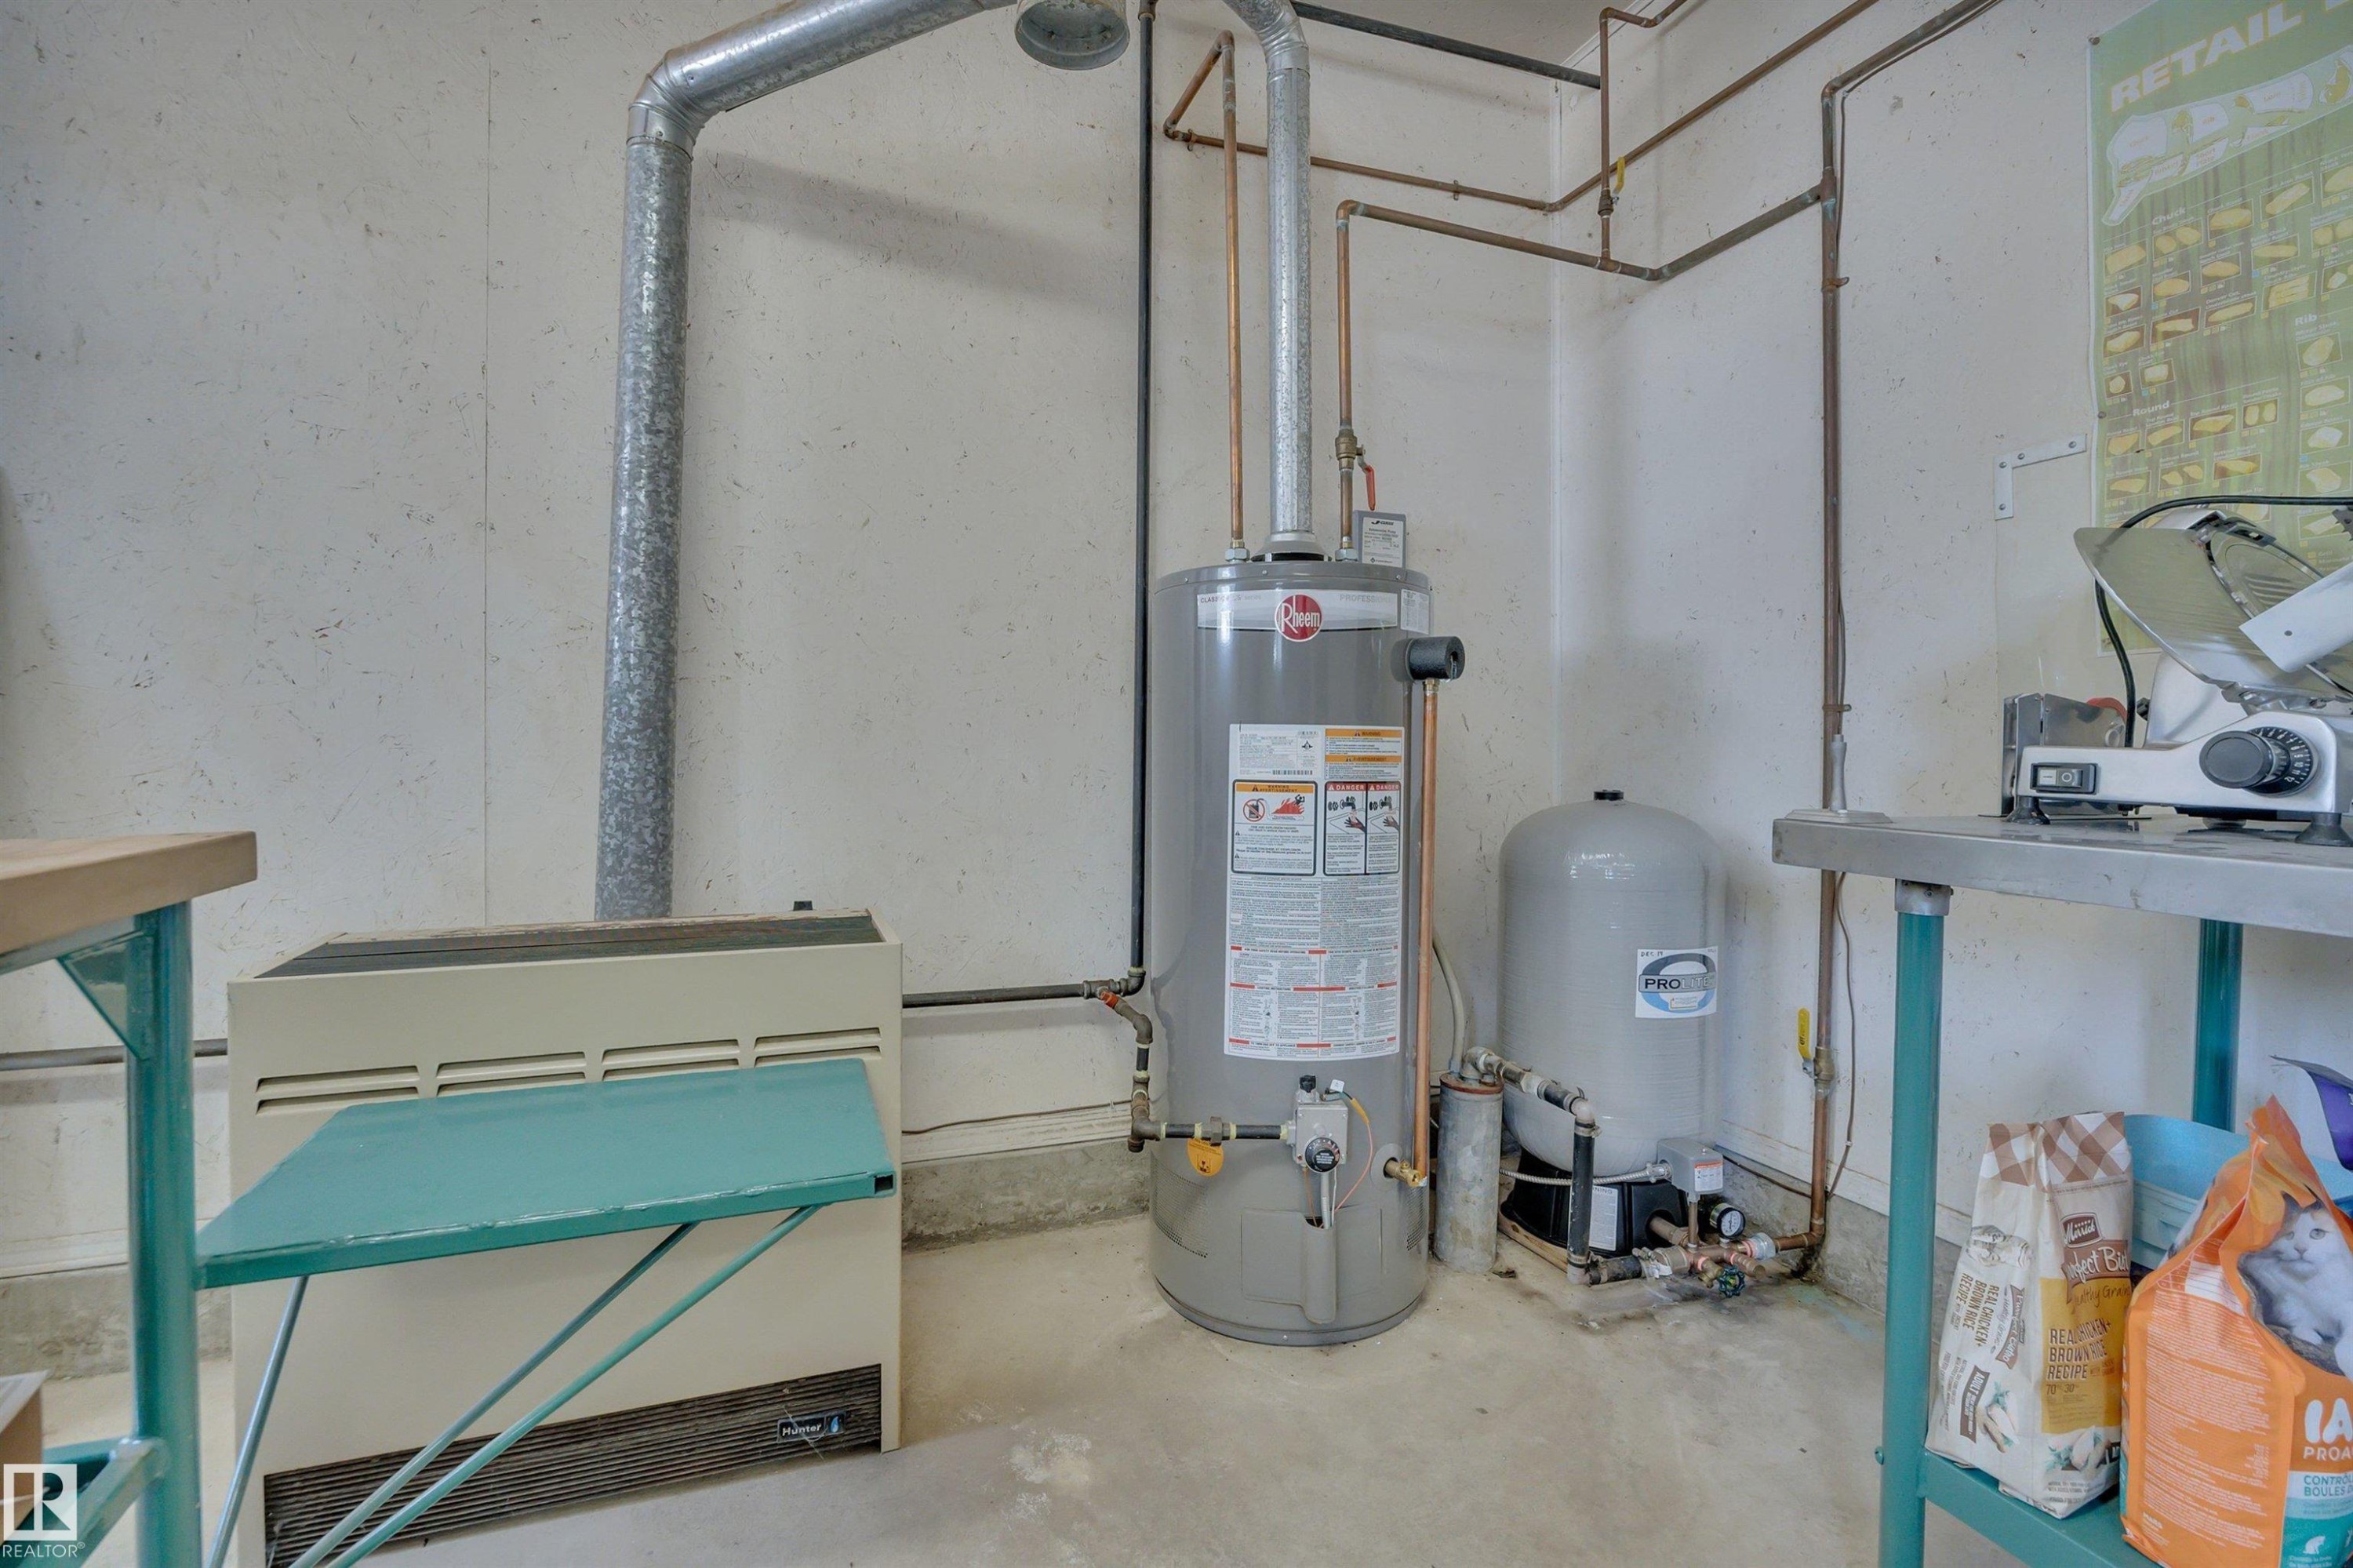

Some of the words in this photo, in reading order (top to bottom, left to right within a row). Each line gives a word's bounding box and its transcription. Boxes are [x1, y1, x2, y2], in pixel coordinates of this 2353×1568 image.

[2110, 2, 2303, 112] RETAIL
[2152, 206, 2187, 225] Chuck
[2295, 313, 2318, 326] Rib
[2133, 400, 2170, 417] Round
[1281, 595, 1321, 635] Rheem
[1644, 976, 1710, 991] PROLITE
[2064, 1219, 2097, 1245] Merrick
[1956, 1272, 1973, 1304] RECIPE
[1966, 1279, 1988, 1312] BROWN
[1984, 1284, 2000, 1308] REAL
[1962, 1310, 1978, 1331] RICE
[1975, 1306, 1995, 1348] CHICKEN+
[2049, 1328, 2077, 1346] REAL
[2076, 1317, 2113, 1343] CHICKEN+
[2048, 1346, 2089, 1363] BROWN
[2089, 1338, 2108, 1362] RICE
[1969, 1371, 1985, 1395] ADULT
[2046, 1363, 2089, 1381] RECIPE
[782, 1423, 823, 1437] Hunter
[2303, 1446, 2353, 1462] PROA
[2304, 1486, 2346, 1497] BOULES
